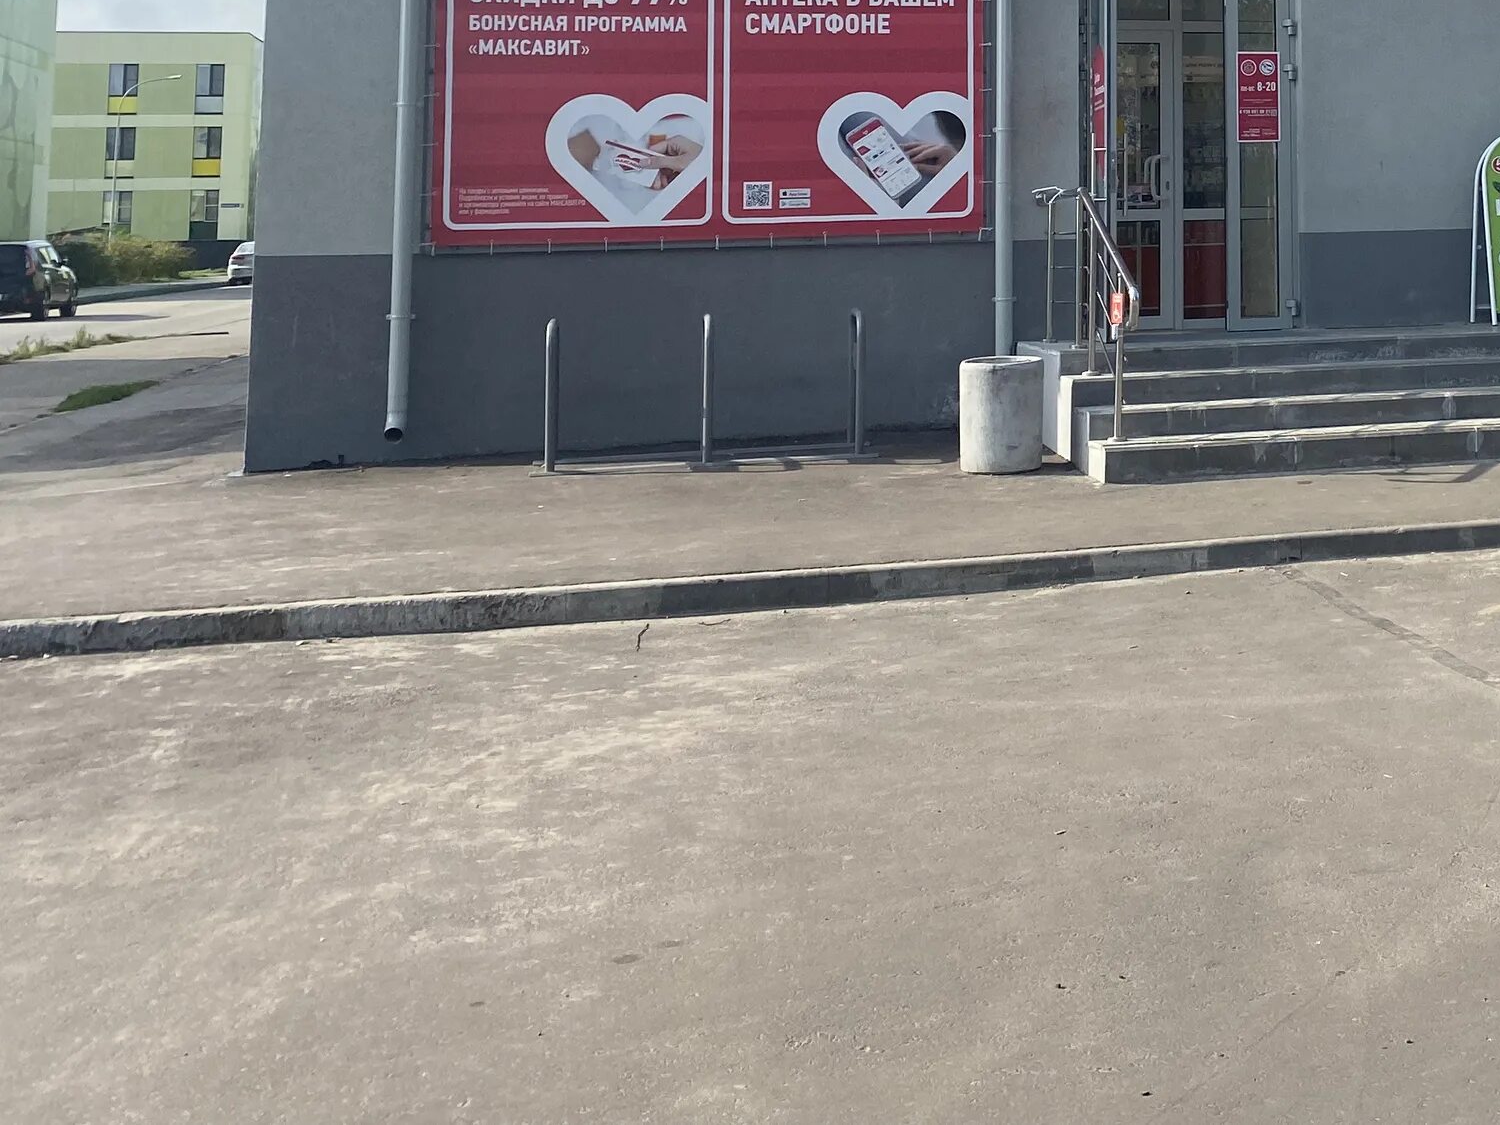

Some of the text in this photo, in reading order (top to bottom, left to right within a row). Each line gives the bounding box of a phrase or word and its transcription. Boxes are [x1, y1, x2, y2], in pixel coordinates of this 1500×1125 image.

[468, 15, 688, 32] БОНУСНАЯ ПРОГРАММА
[745, 13, 891, 34] СМАРТФОНЕ
[468, 39, 590, 56] «МАКСАВИТ»
[1257, 81, 1276, 92] 8-20
